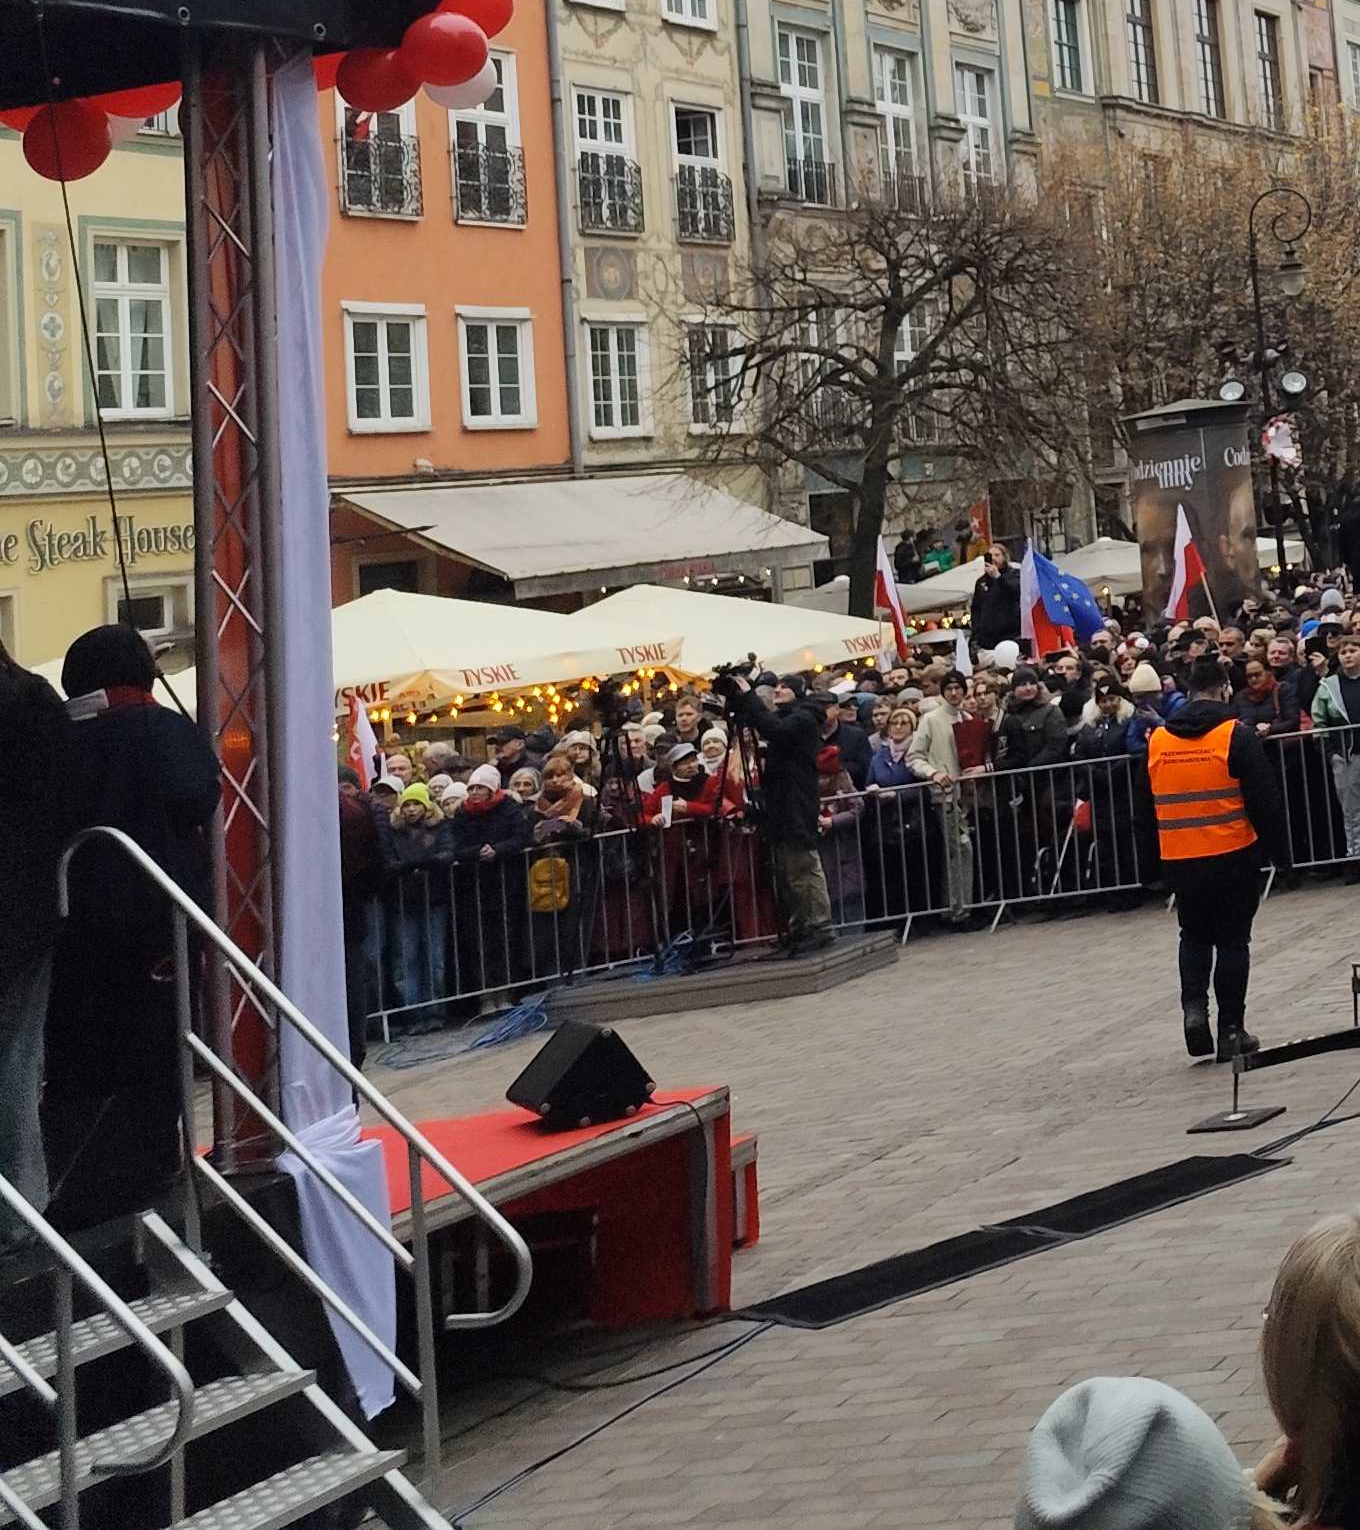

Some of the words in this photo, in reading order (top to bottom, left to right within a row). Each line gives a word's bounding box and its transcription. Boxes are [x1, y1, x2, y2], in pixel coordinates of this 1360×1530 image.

[27, 515, 109, 575] Steak
[112, 515, 196, 569] House
[615, 642, 668, 665] TYSKIE
[458, 663, 522, 687] TYSKIE
[334, 680, 391, 709] YSKIE
